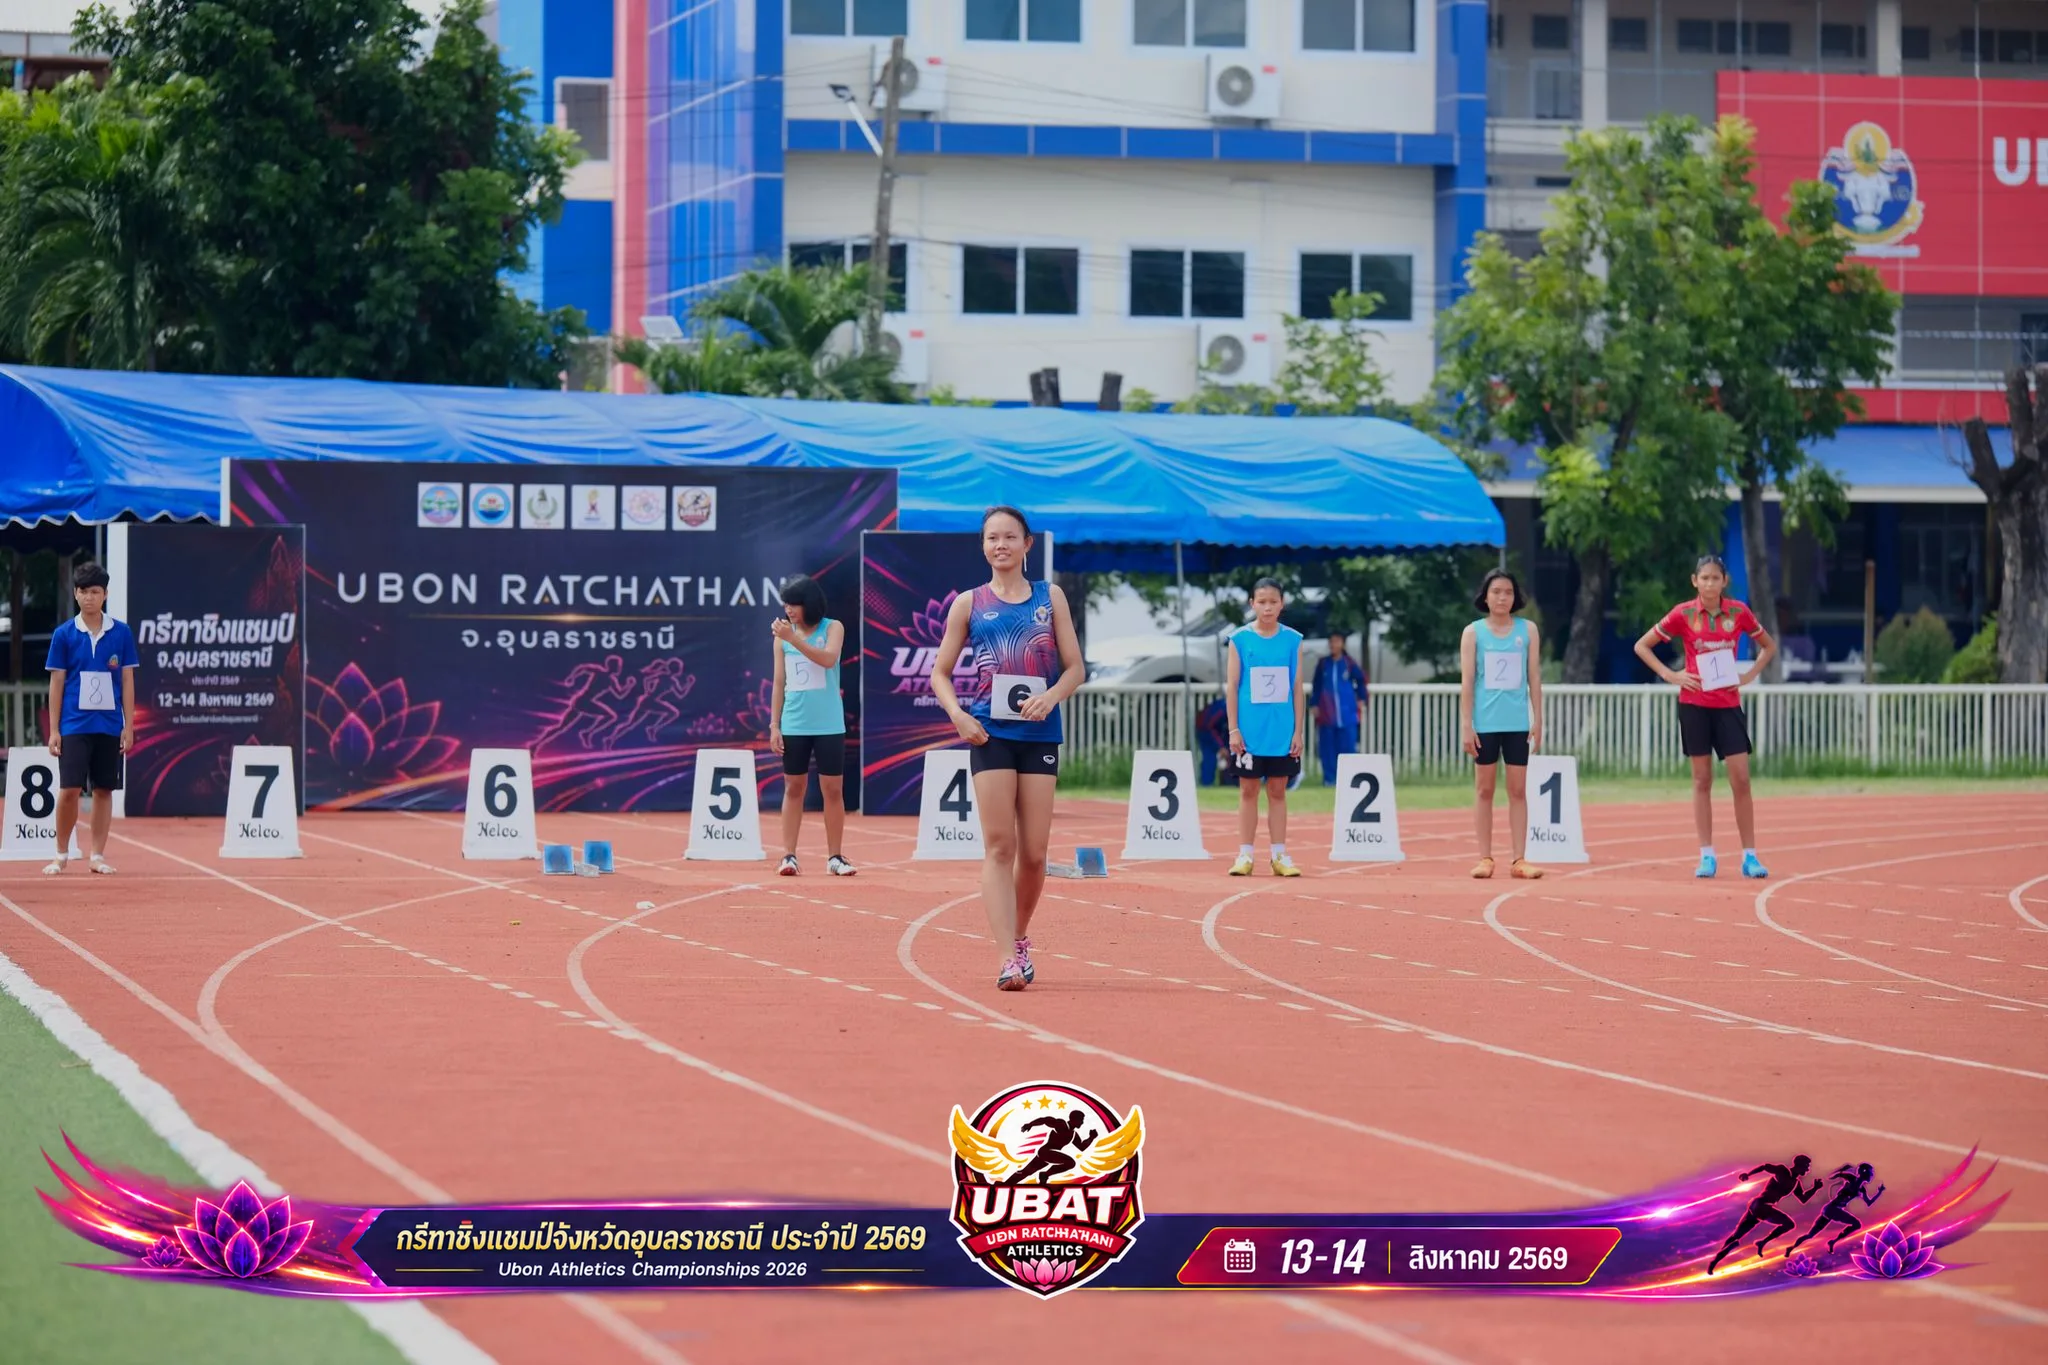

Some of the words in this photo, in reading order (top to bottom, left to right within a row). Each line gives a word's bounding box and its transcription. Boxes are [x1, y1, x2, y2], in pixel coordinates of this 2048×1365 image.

[337, 572, 477, 605] UBON
[461, 624, 675, 656] จ.อุบลราชธานี
[157, 645, 273, 674] จ.อุบลราชธานี
[795, 661, 810, 685] 5
[1494, 658, 1508, 681] 2
[89, 676, 103, 705] 8
[158, 692, 195, 707] 12-14
[199, 692, 242, 707] สิงหาคม
[245, 692, 275, 707] 2569
[1007, 684, 1032, 713] 6
[1261, 674, 1276, 698] 3
[20, 765, 55, 818] 8
[244, 765, 279, 818] 7
[483, 764, 518, 818] 6
[708, 767, 742, 820] 5
[939, 769, 972, 822] 4
[1147, 768, 1180, 821] 3
[1350, 772, 1381, 823] 2
[1539, 772, 1562, 824] 1
[16, 824, 57, 839] Nelco
[239, 823, 280, 838] Nelco
[477, 822, 518, 838] Nelco
[703, 824, 742, 840] Nelco
[935, 826, 974, 841] Nelco
[1142, 825, 1180, 840] Nelco
[1345, 829, 1383, 843] Nelco
[1530, 826, 1566, 843] Nelco
